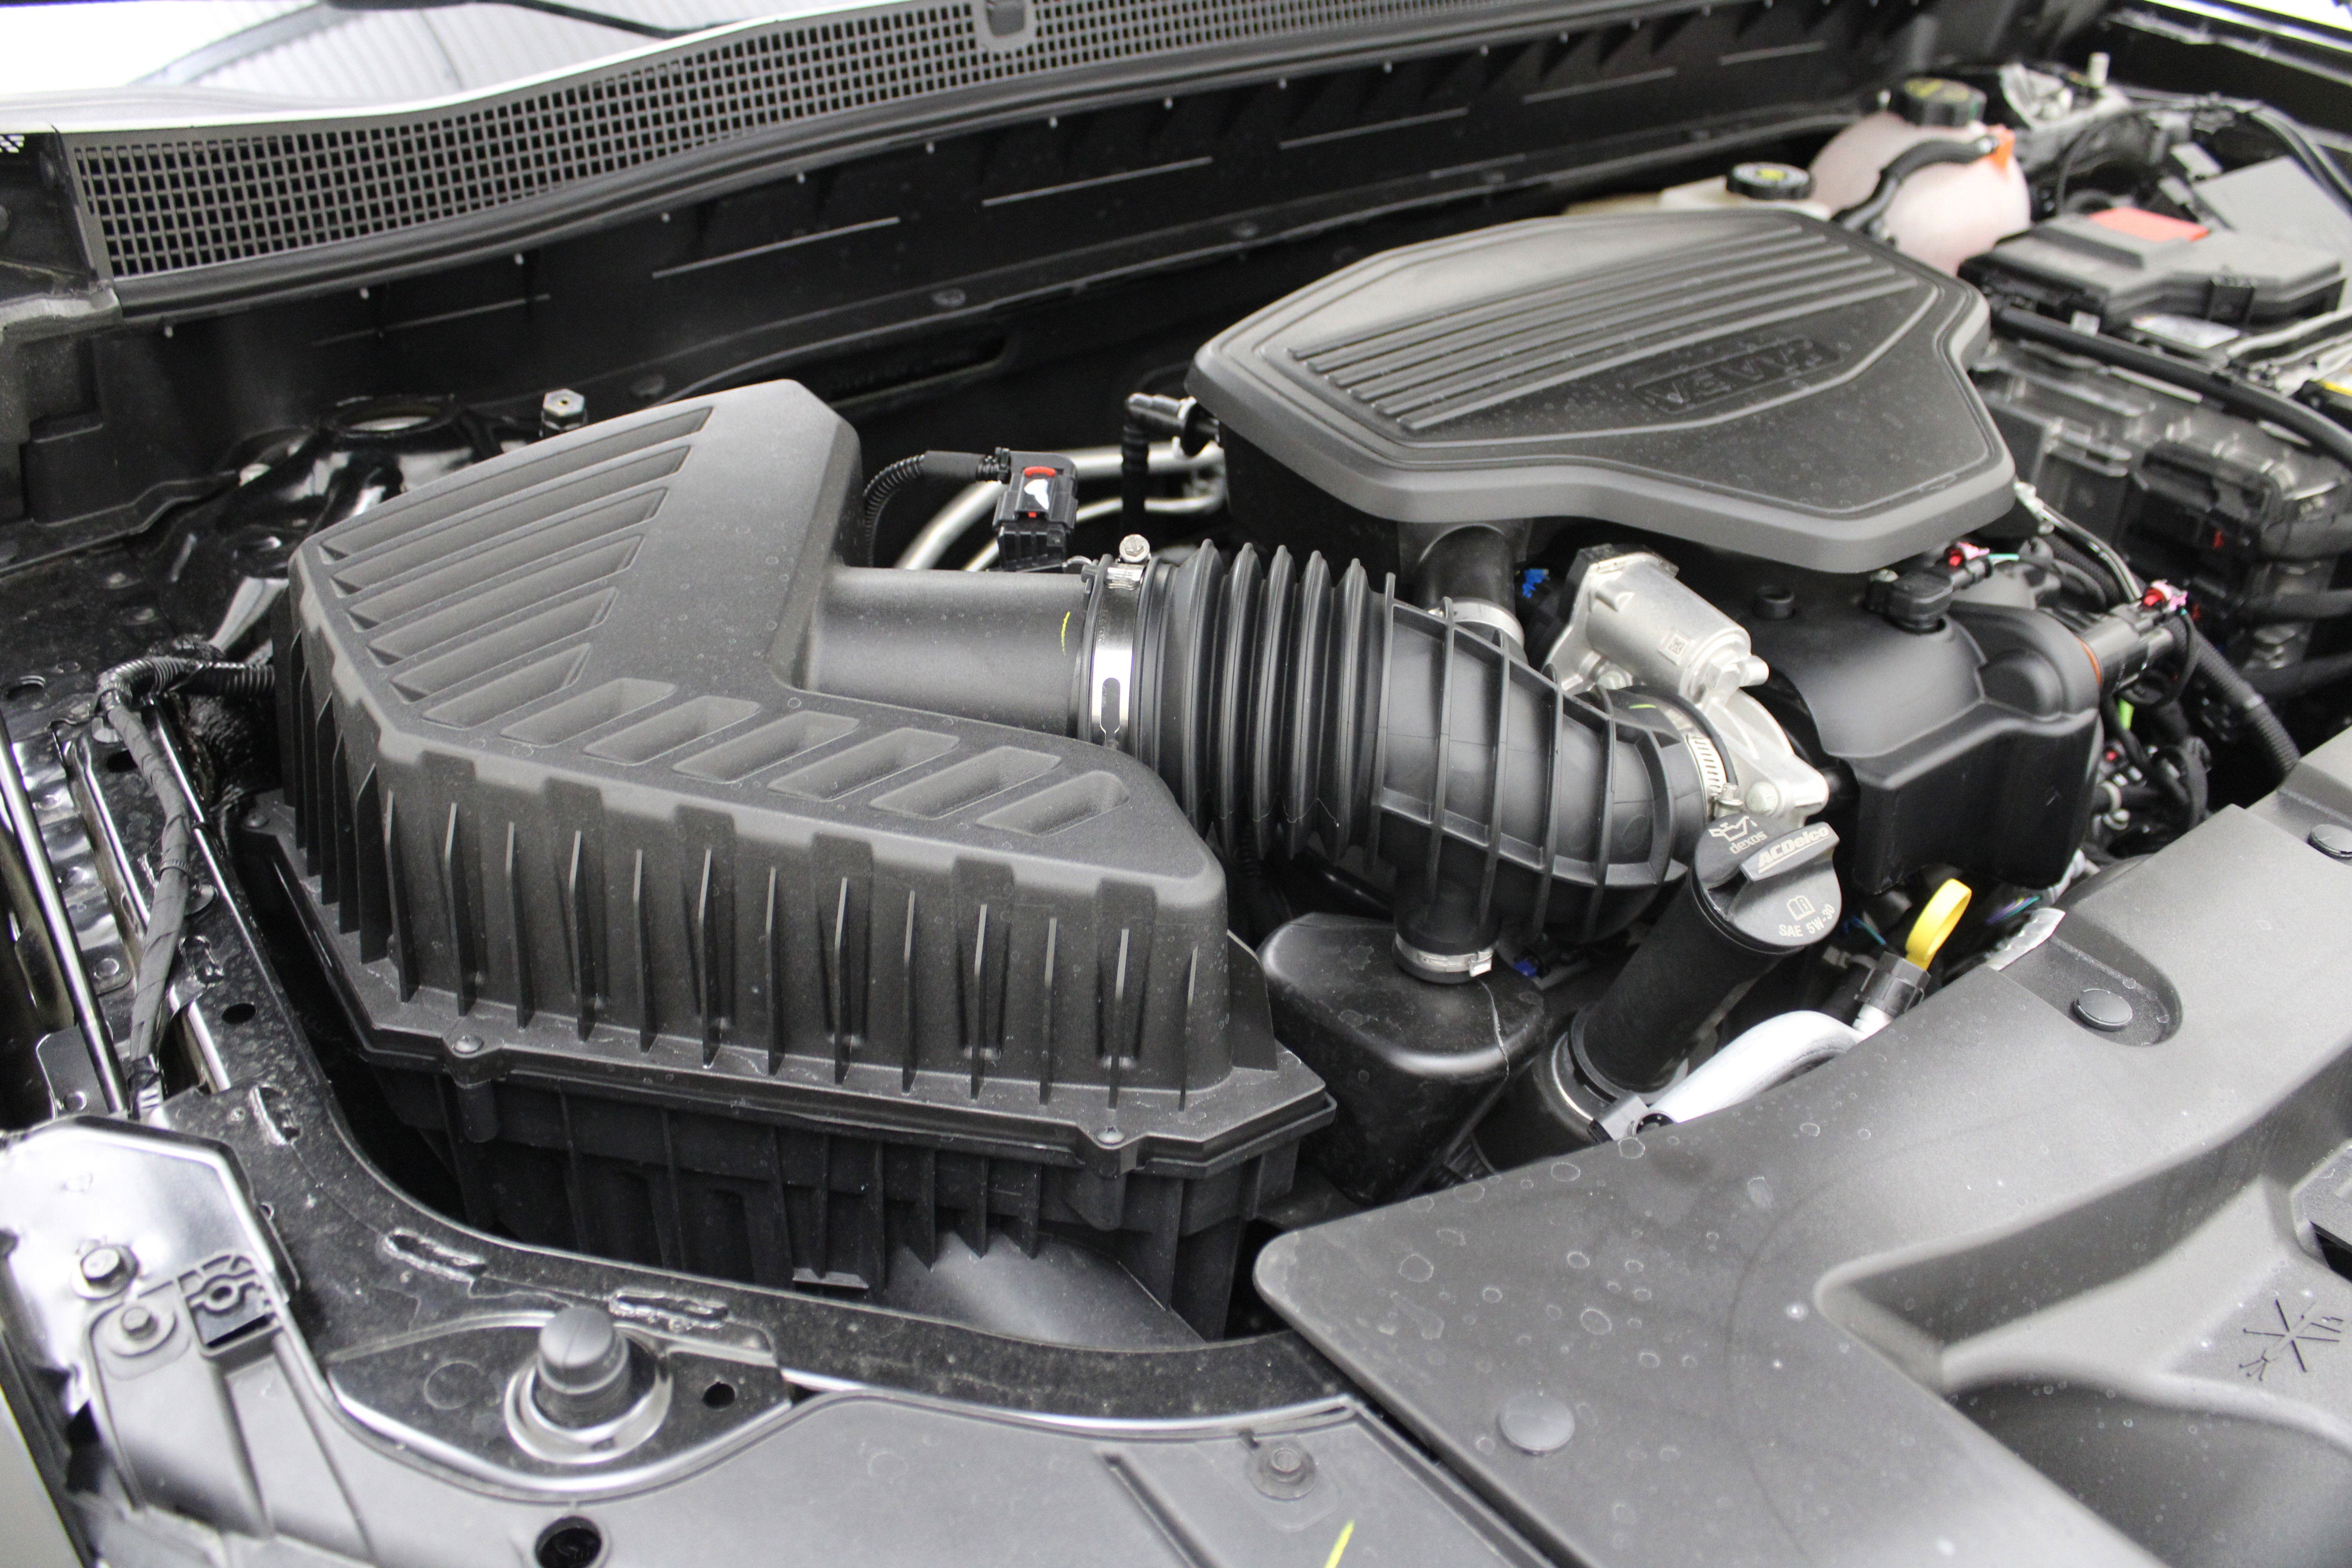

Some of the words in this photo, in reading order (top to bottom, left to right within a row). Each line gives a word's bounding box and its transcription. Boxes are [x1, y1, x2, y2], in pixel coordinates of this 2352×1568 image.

[1729, 831, 1768, 854] dexos
[1759, 826, 1830, 869] ACDelco
[1779, 924, 1804, 937] SAE
[1806, 903, 1835, 934] 5W-30
